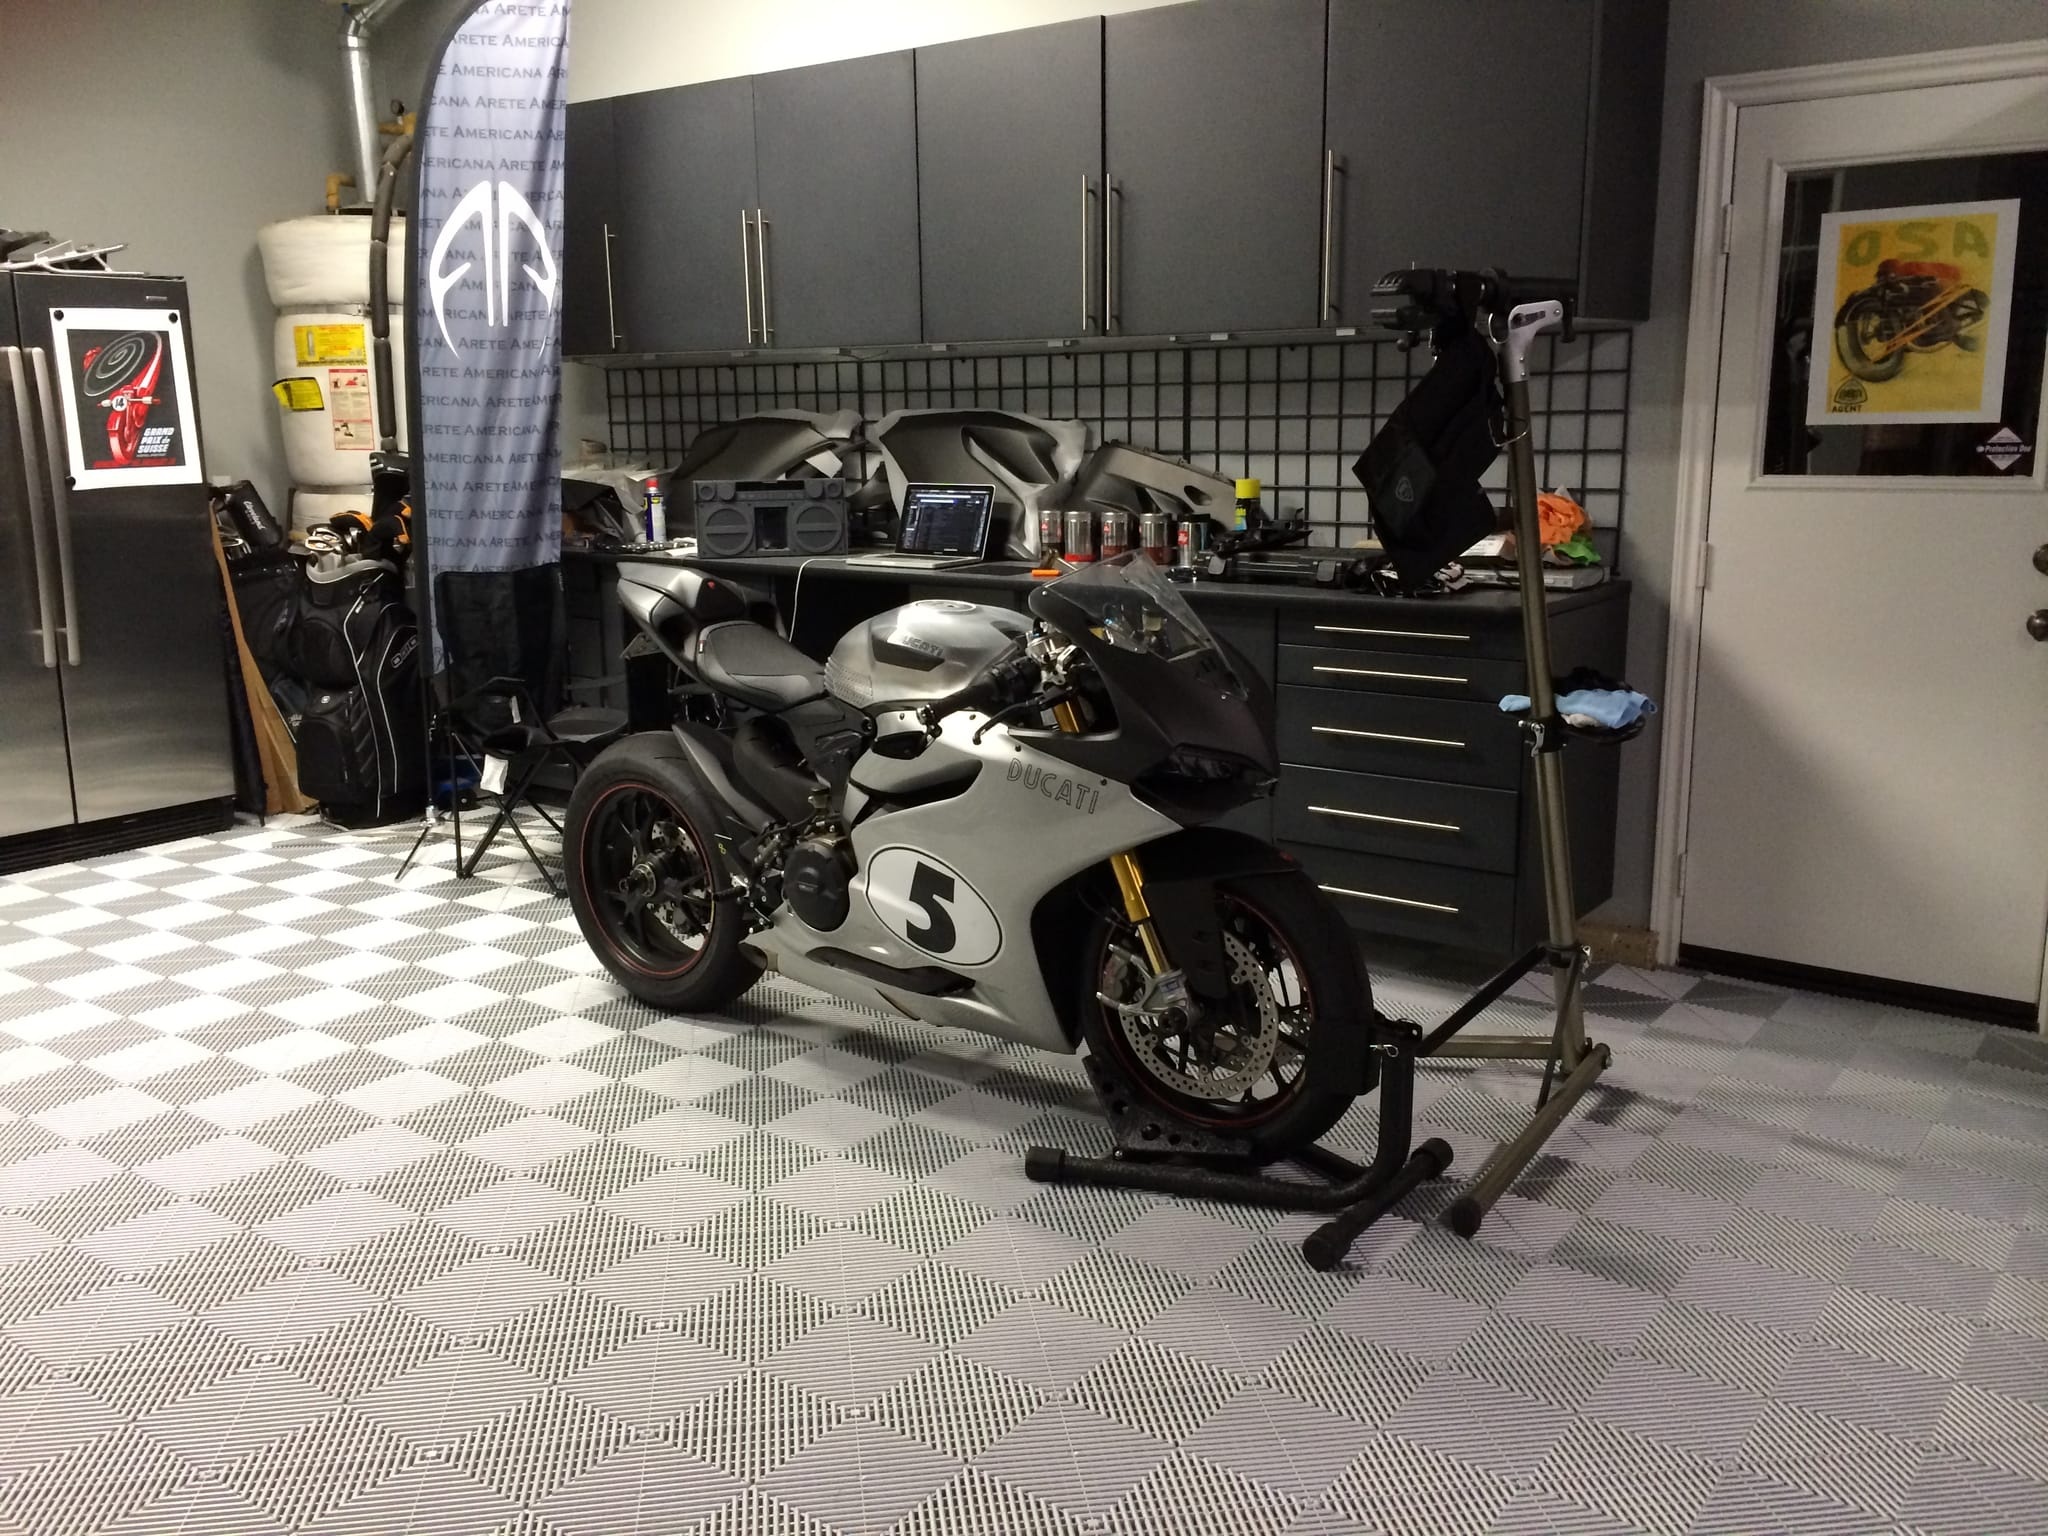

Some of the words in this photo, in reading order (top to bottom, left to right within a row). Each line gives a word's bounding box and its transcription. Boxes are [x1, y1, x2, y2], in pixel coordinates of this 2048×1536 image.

[495, 3, 546, 16] ARETE
[451, 64, 542, 79] AMERICANA
[474, 95, 527, 109] ARETE
[453, 126, 543, 140] AMERICANA
[458, 337, 506, 349] ARETE
[1832, 404, 1862, 413] AGENT
[144, 427, 175, 436] GRAND
[141, 436, 163, 444] PRIX
[137, 444, 169, 453] SUISSE
[1007, 758, 1099, 815] DUCATI
[906, 860, 956, 954] 5
